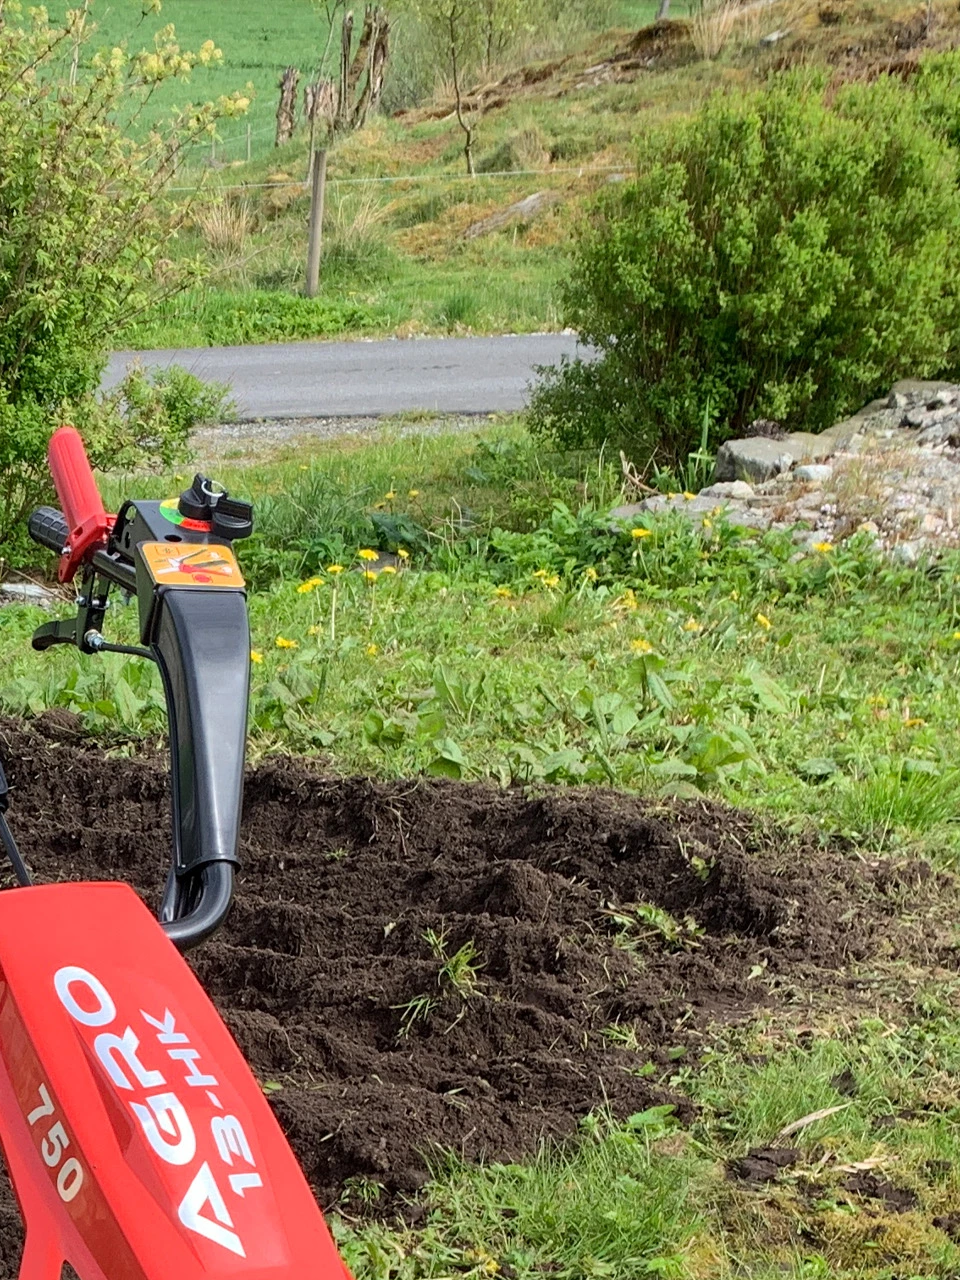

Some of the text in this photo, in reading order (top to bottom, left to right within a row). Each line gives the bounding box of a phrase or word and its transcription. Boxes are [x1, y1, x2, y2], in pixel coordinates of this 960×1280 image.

[27, 1083, 84, 1203] 750
[53, 965, 246, 1257] AGRO
[139, 1008, 263, 1198] 13-HK
